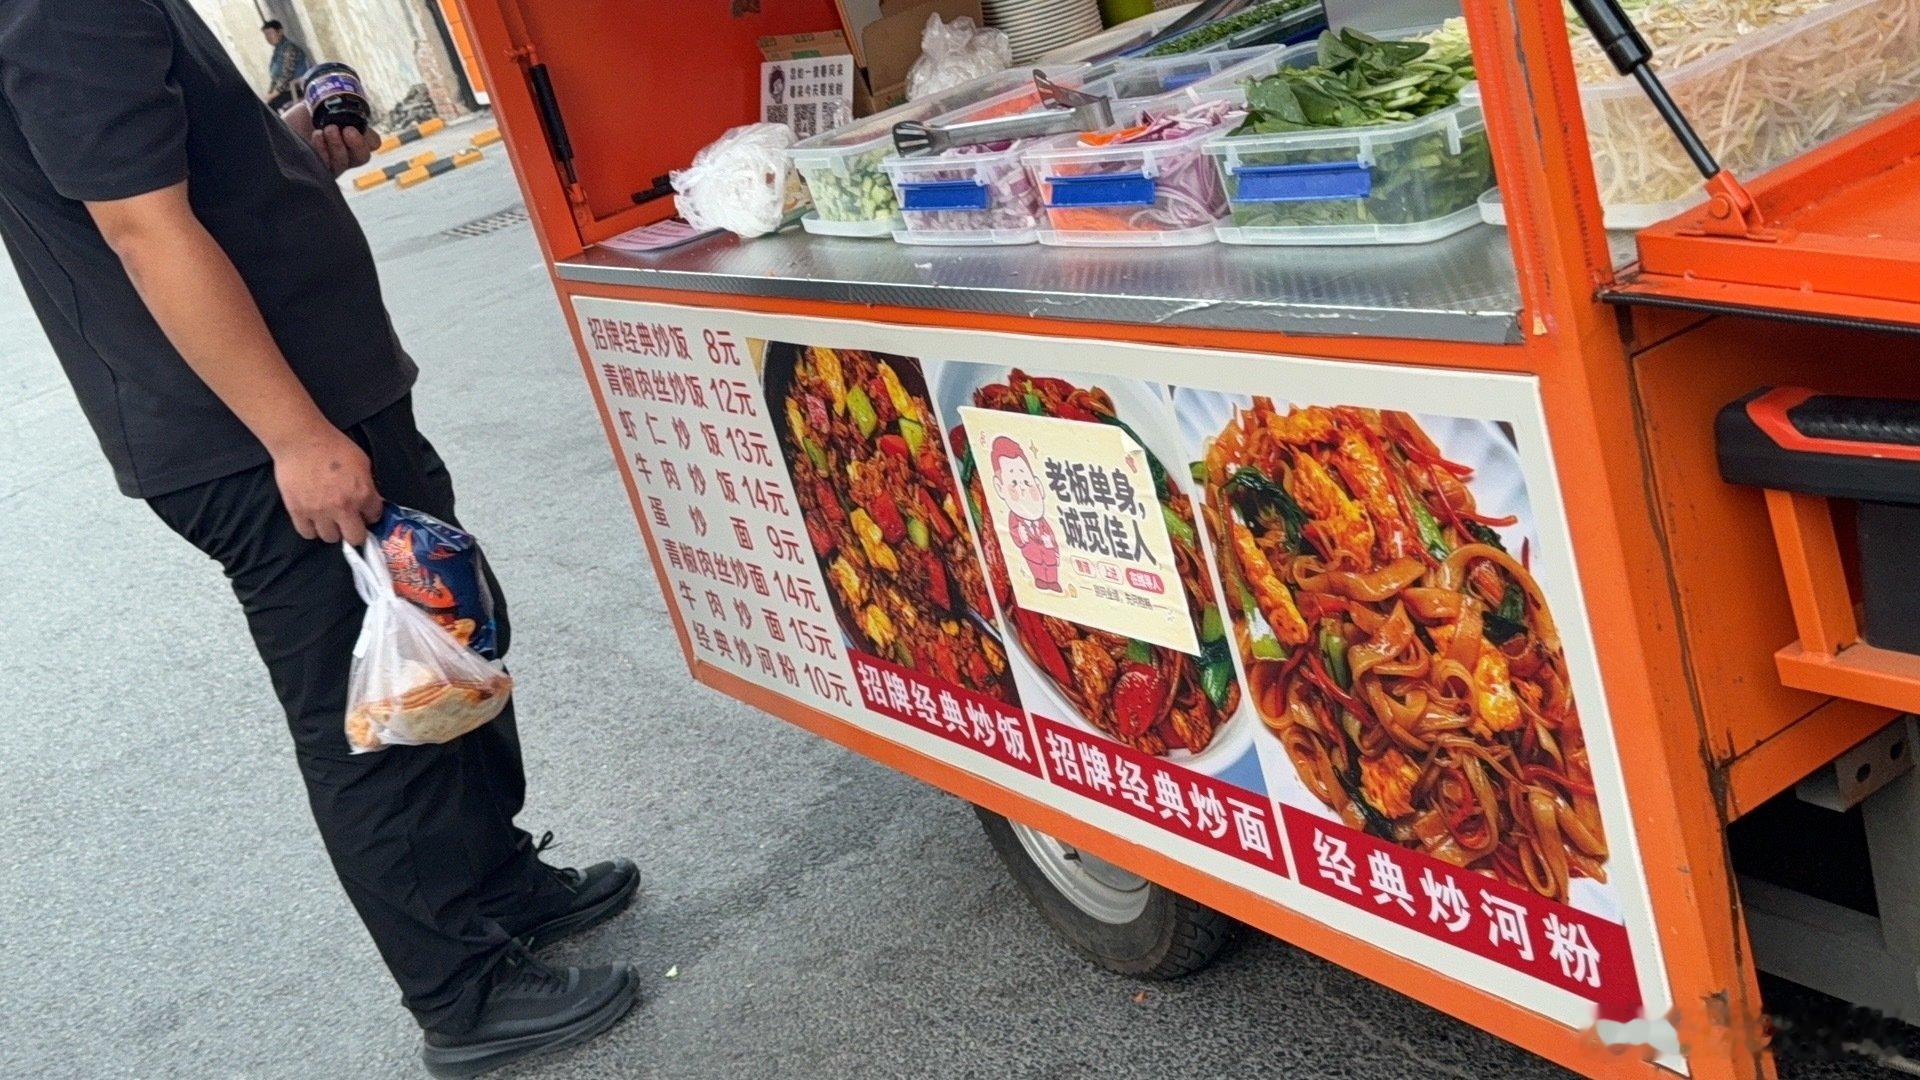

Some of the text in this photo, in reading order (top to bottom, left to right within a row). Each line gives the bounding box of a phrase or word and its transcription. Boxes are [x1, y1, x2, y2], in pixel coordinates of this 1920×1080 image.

[587, 316, 741, 366] 招牌经典炒饭 8元
[602, 362, 756, 417] 青椒肉丝炒饭 12元
[726, 427, 773, 467] 13元
[742, 475, 789, 516] 14元
[766, 525, 804, 564] 9元
[1057, 506, 1157, 565] 诚觅佳人
[662, 538, 821, 612] 青椒肉丝炒面 14元
[692, 620, 852, 707] 经典炒河粉 10元
[789, 617, 836, 660] 15元
[857, 660, 1033, 764] 招牌经典炒饭
[1048, 730, 1274, 860] 招牌经典炒面
[1313, 827, 1601, 988] 经典炒河粉
